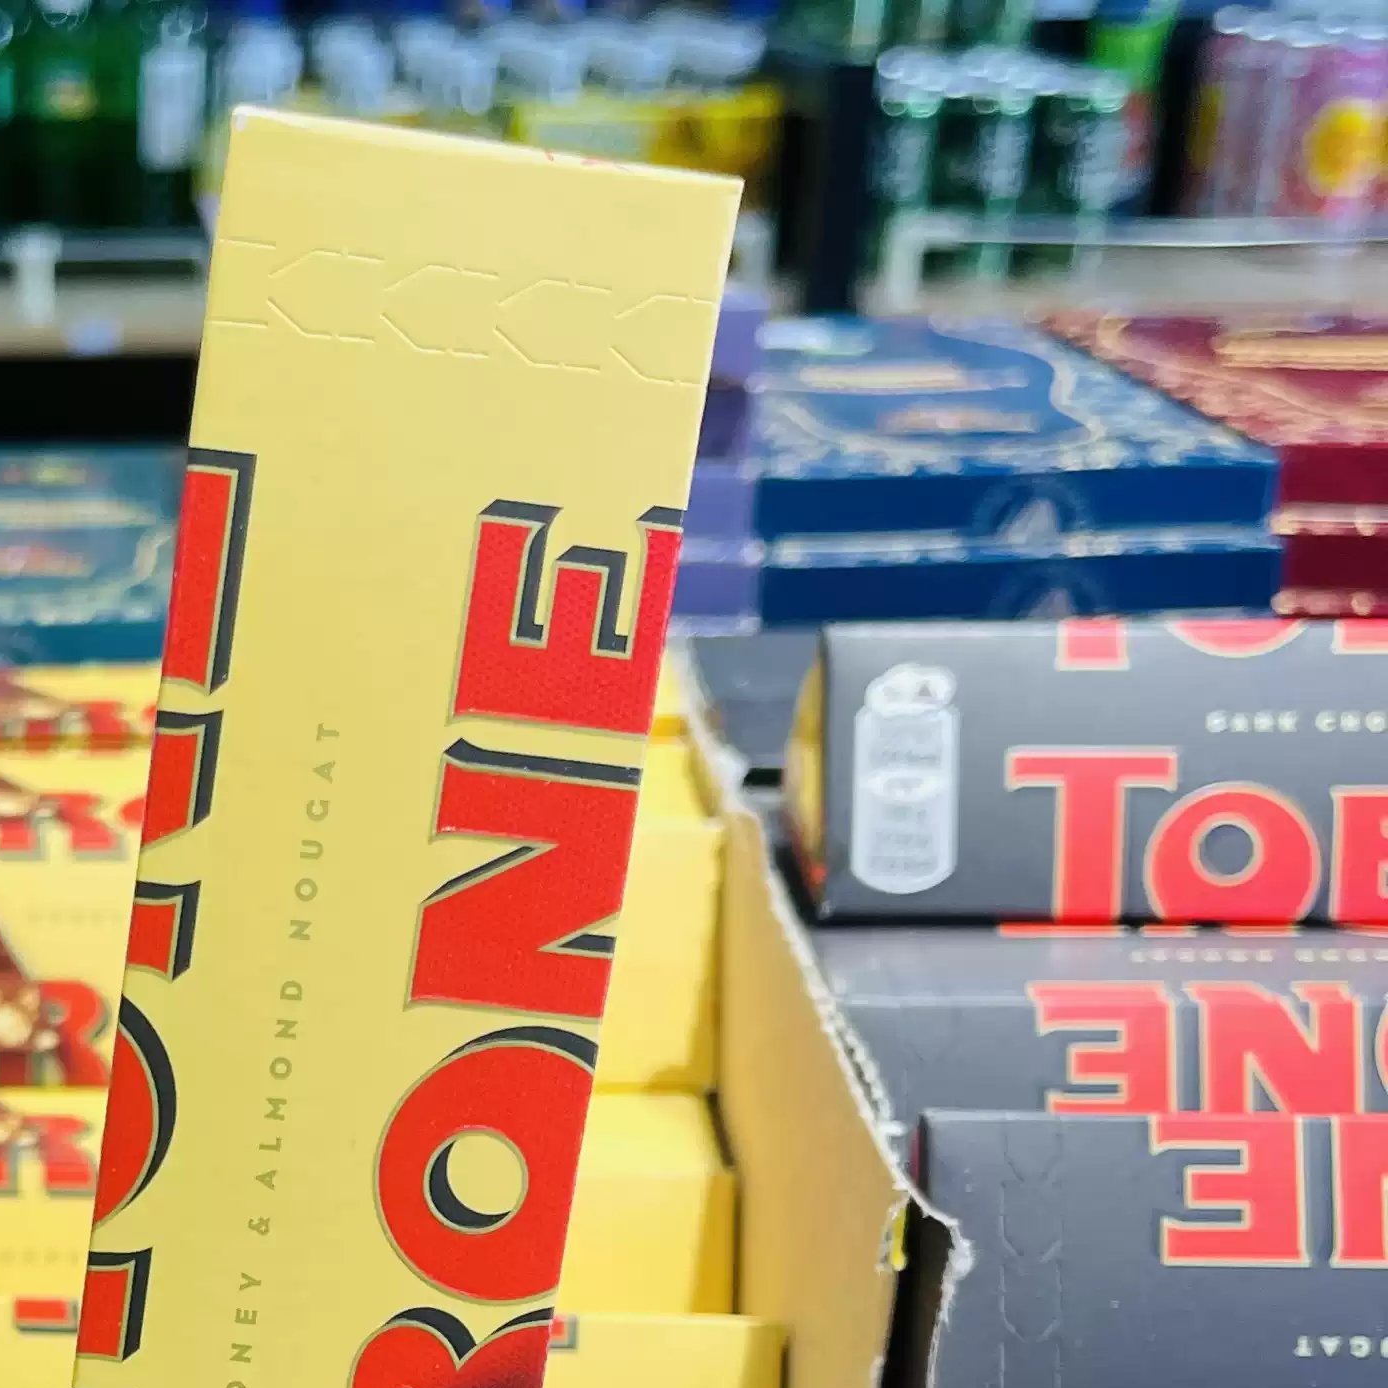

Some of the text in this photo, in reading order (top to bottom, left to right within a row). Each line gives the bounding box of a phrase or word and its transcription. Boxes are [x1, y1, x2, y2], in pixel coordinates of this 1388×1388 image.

[289, 722, 340, 942] NOUGAT
[255, 979, 303, 1190] ALMOND
[247, 1214, 271, 1237] &
